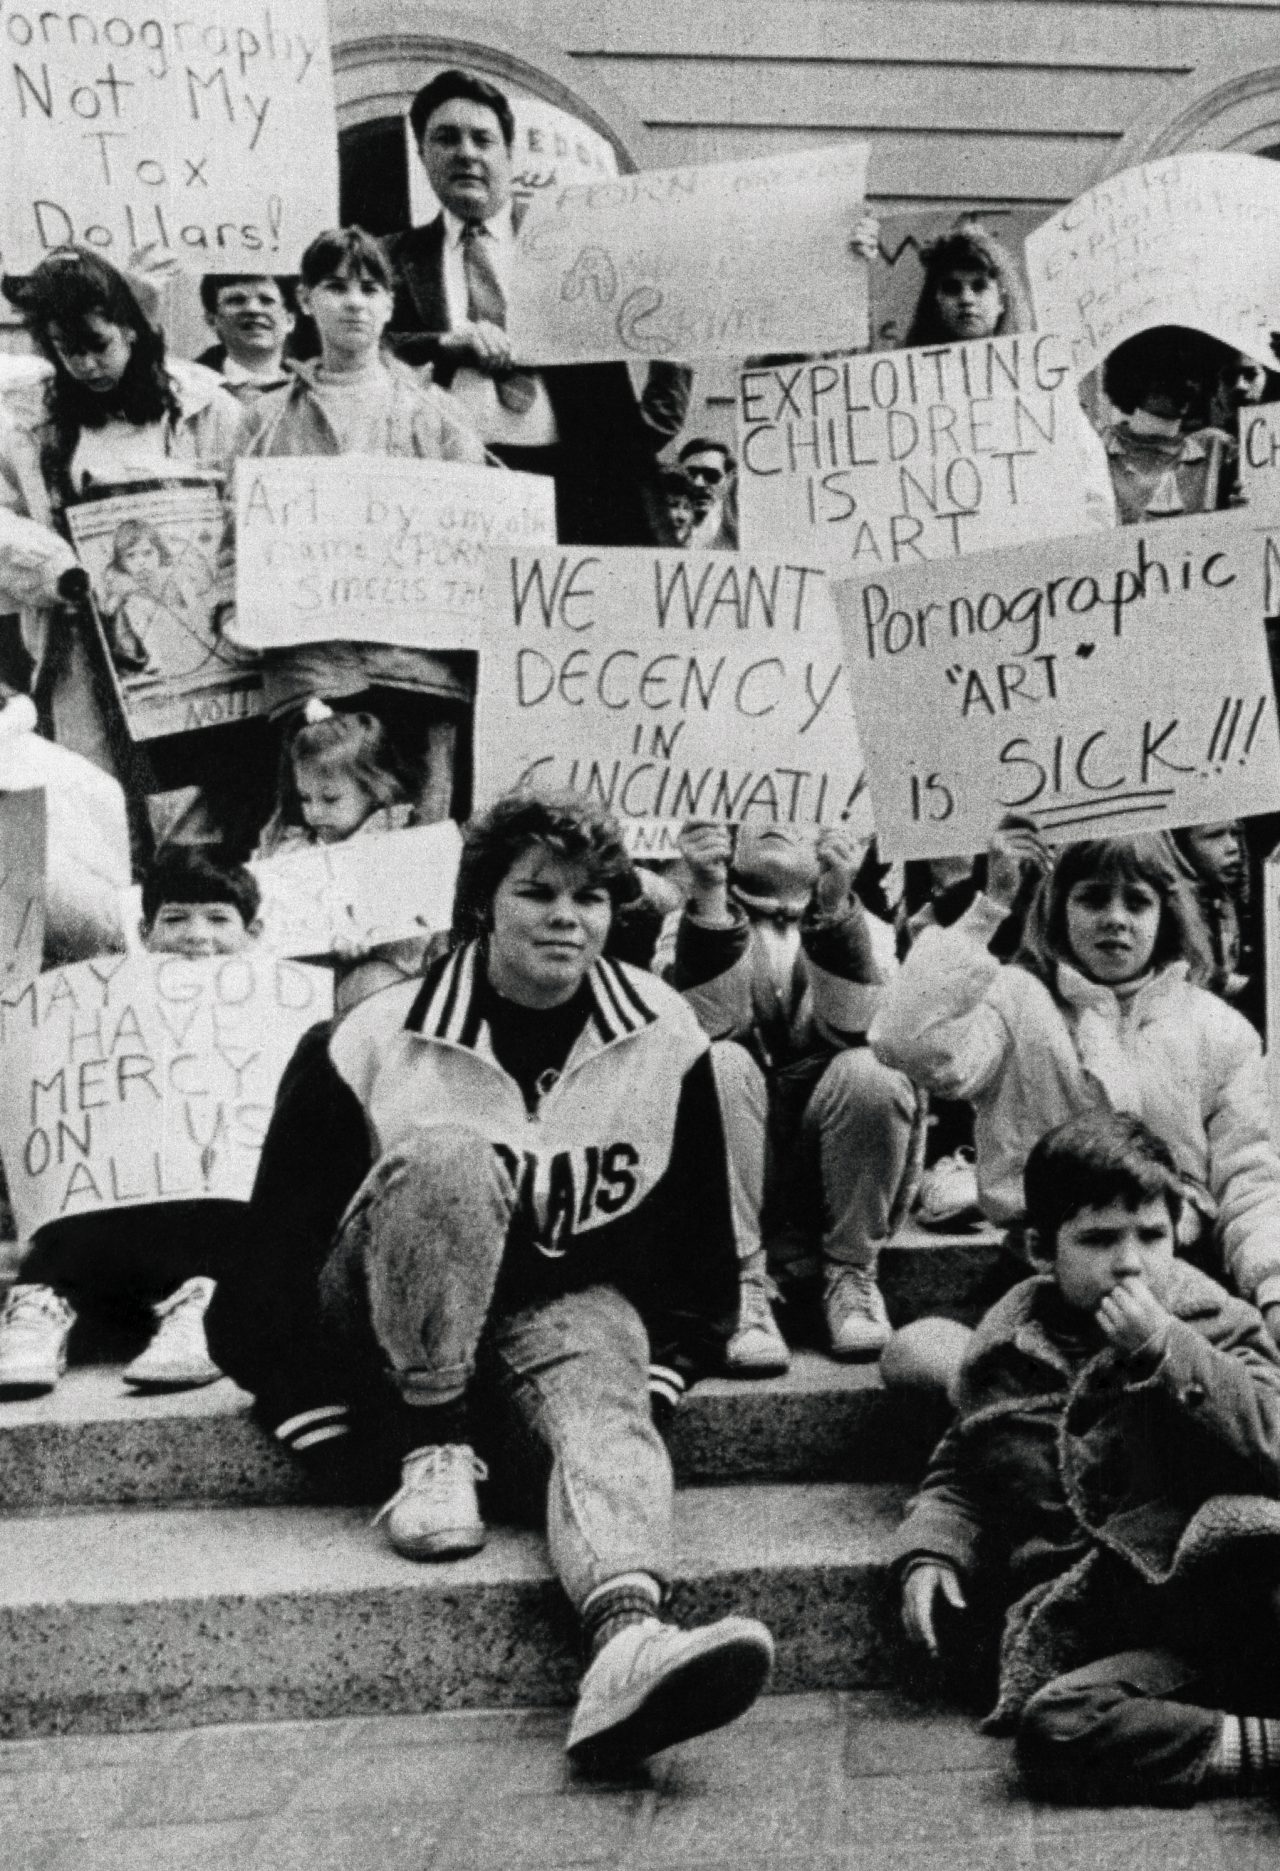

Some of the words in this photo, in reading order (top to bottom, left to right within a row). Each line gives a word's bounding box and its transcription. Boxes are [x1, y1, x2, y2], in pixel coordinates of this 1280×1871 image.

[6, 10, 314, 83] ornography
[13, 62, 134, 119] Not
[185, 65, 270, 150] My
[33, 194, 281, 252] Dollars!
[741, 334, 1069, 423] EXPLOITING
[742, 395, 1056, 476] CHILDREN
[808, 470, 858, 525] IS
[900, 450, 1038, 516] NOT
[853, 509, 980, 563] ART
[509, 556, 600, 632] WE
[653, 559, 826, 631] WANT
[862, 538, 1237, 659] Pornographic
[517, 648, 842, 734] DECENCY
[632, 719, 686, 760] IN
[1, 957, 127, 1042] MAY
[156, 957, 314, 1009] GOD
[68, 1002, 249, 1063] HAVE
[31, 1048, 262, 1128] MERCY
[24, 1113, 91, 1178] ON
